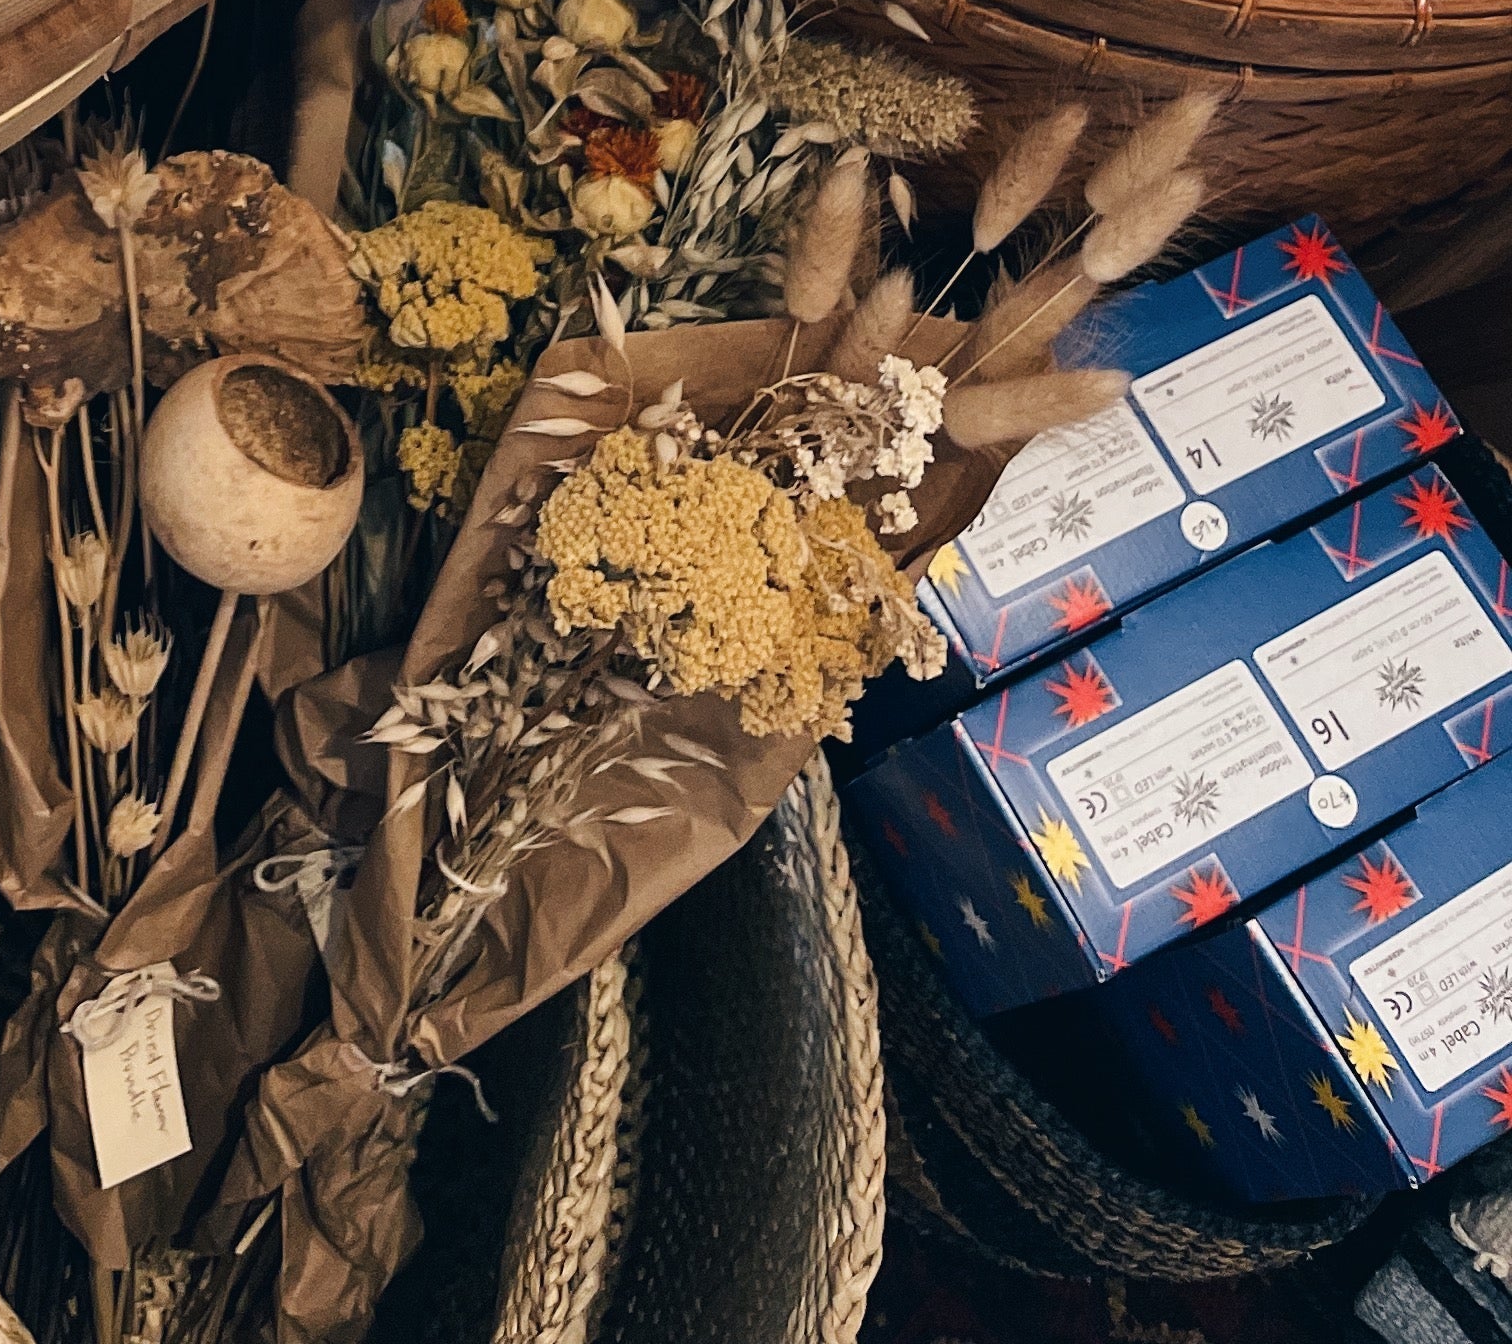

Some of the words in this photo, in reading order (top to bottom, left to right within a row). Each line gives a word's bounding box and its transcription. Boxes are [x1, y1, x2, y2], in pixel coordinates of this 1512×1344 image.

[1186, 438, 1222, 469] 14
[1453, 628, 1483, 649] white
[1311, 709, 1350, 745] 16
[1221, 740, 1283, 779] Illumination
[1258, 754, 1292, 778] Indoor
[1134, 774, 1156, 793] LED
[1132, 822, 1174, 854] Cabel
[1439, 971, 1460, 993] LED
[1459, 960, 1479, 978] with
[1383, 991, 1413, 1021] CE
[145, 1007, 163, 1065] Dried
[1440, 1019, 1482, 1054] Cabel
[1418, 1051, 1430, 1062] m
[1429, 1047, 1437, 1058] 4
